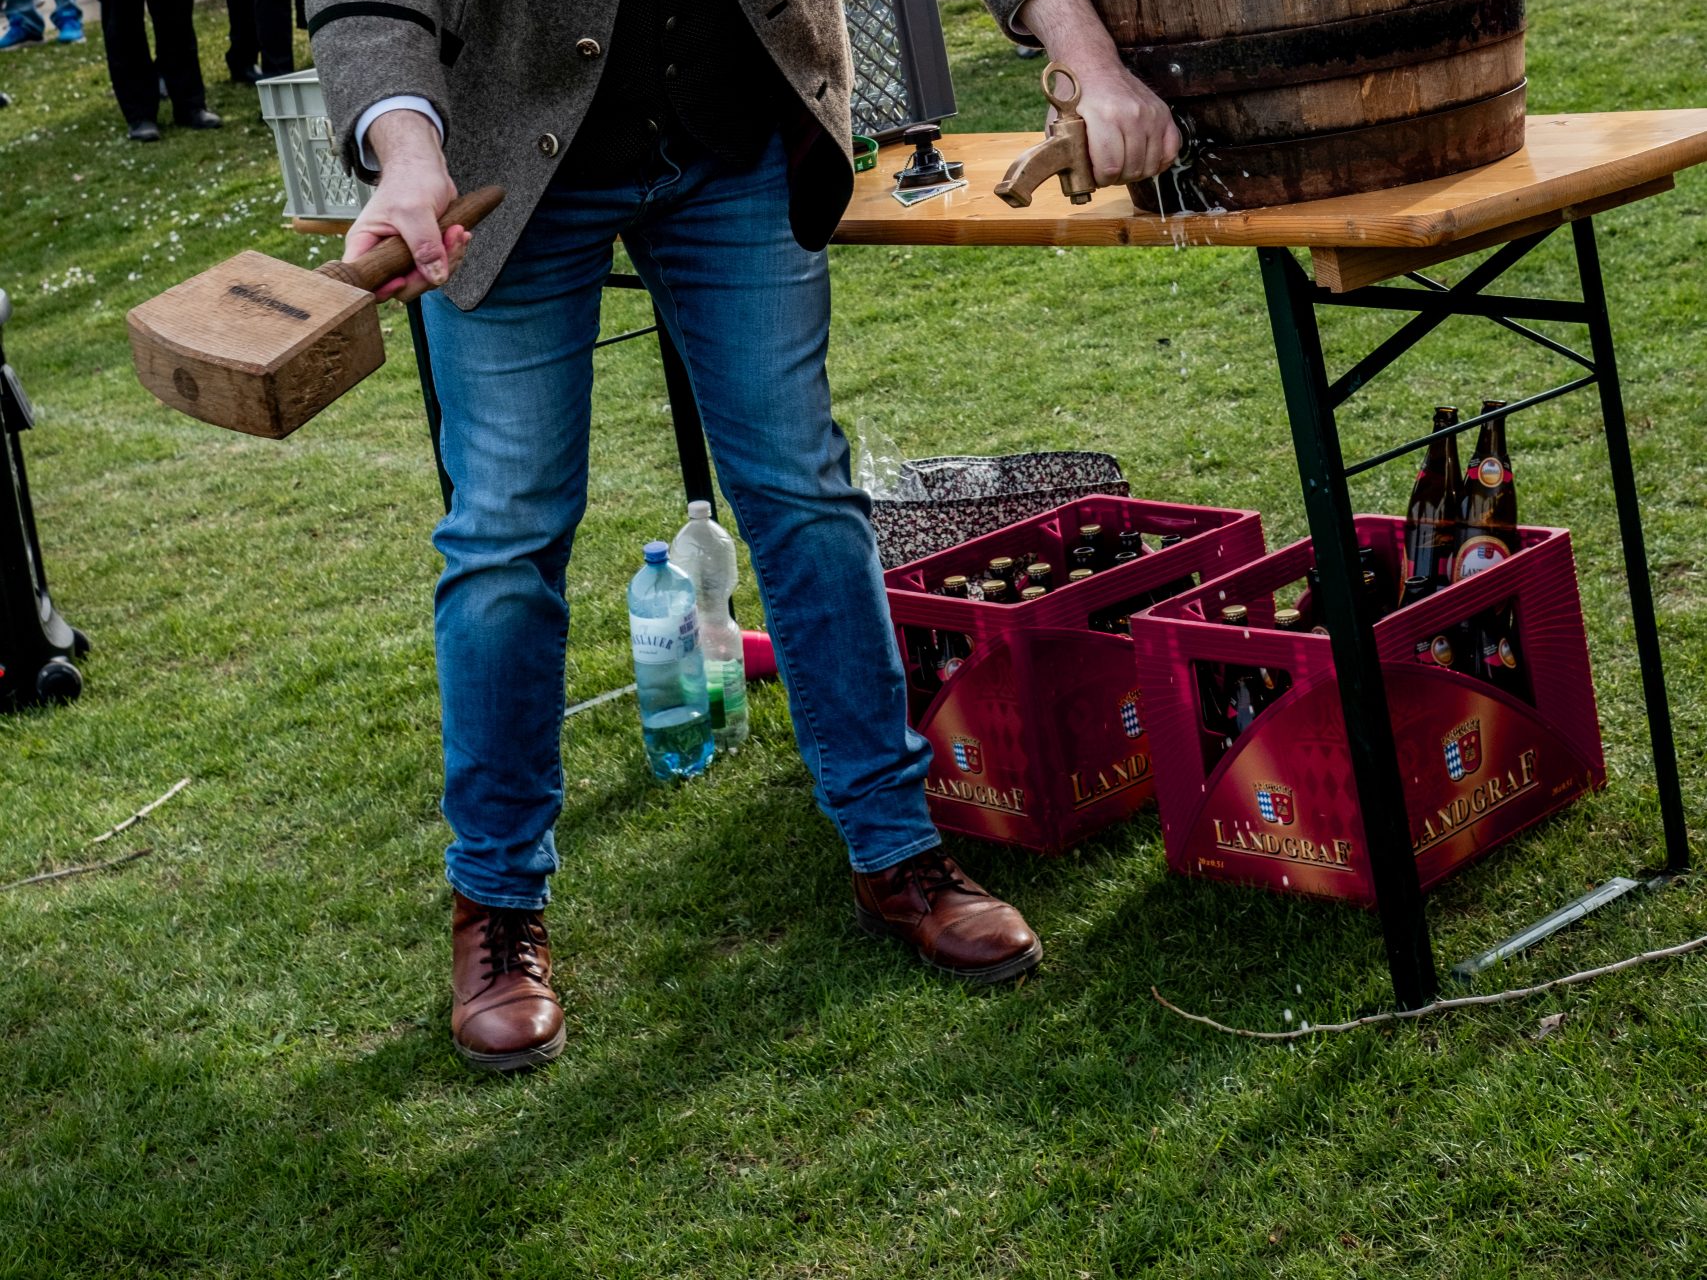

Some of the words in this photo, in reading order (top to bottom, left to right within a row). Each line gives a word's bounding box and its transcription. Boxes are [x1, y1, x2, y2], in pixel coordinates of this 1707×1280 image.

[923, 777, 1025, 812] LANDGRAF
[1070, 752, 1153, 804] LAND
[1412, 748, 1537, 849] ANDGRAF
[1212, 818, 1352, 866] LANDGRAF
